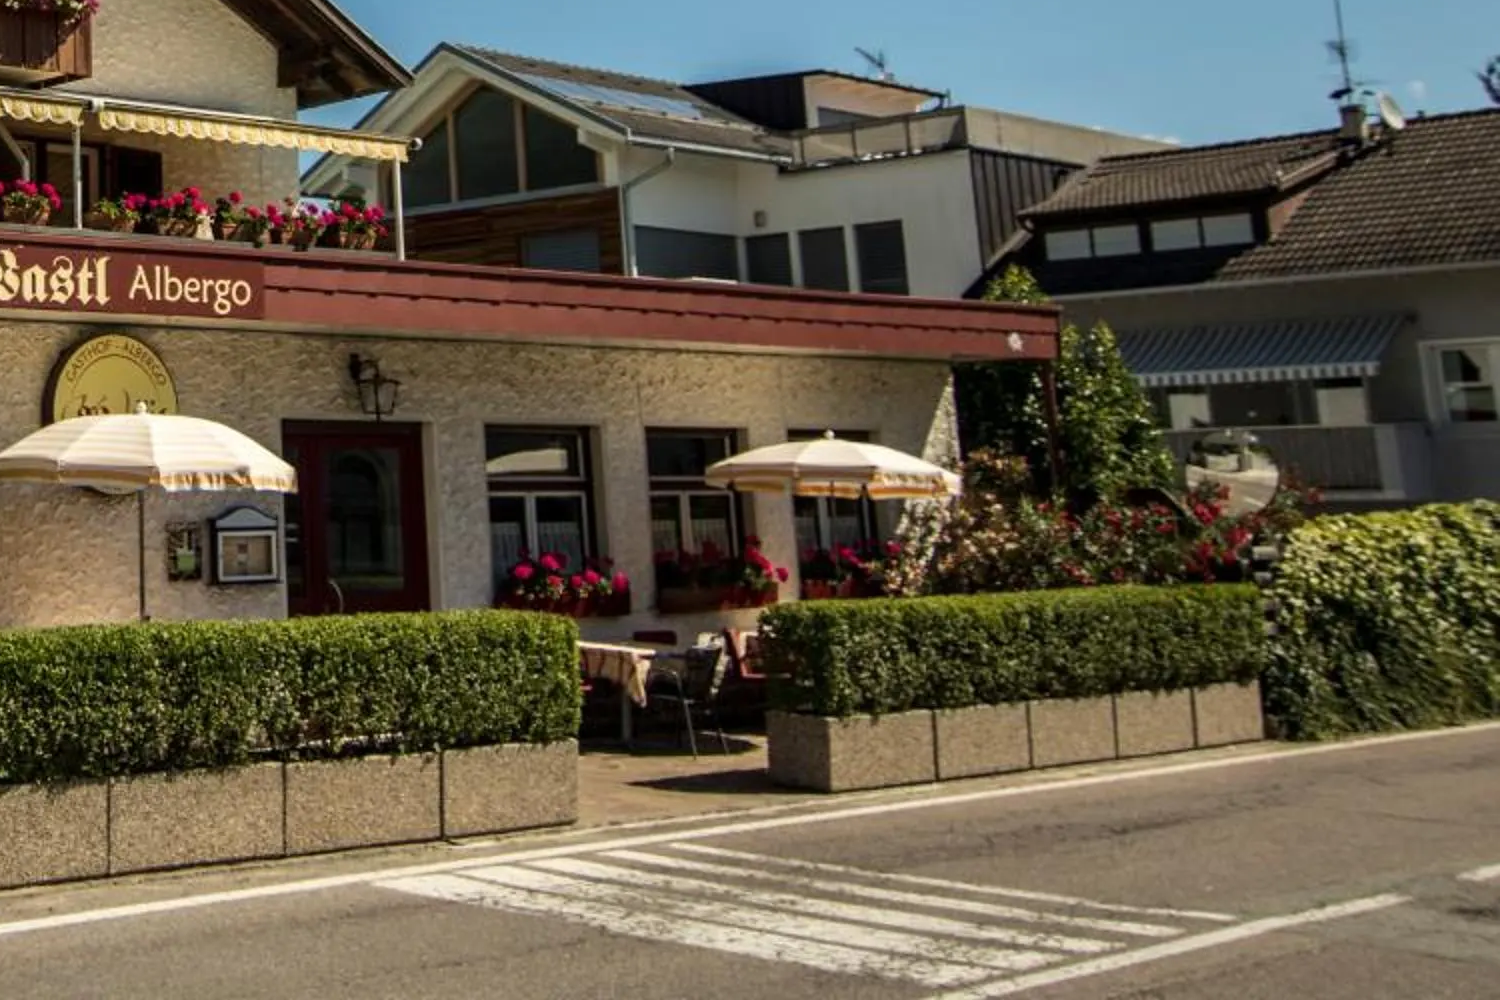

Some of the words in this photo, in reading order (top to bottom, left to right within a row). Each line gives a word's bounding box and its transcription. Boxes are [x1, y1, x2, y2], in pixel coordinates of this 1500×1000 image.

[128, 264, 252, 315] Albergo
[65, 339, 111, 382] GASTHOF
[123, 341, 167, 385] ALBERGO
